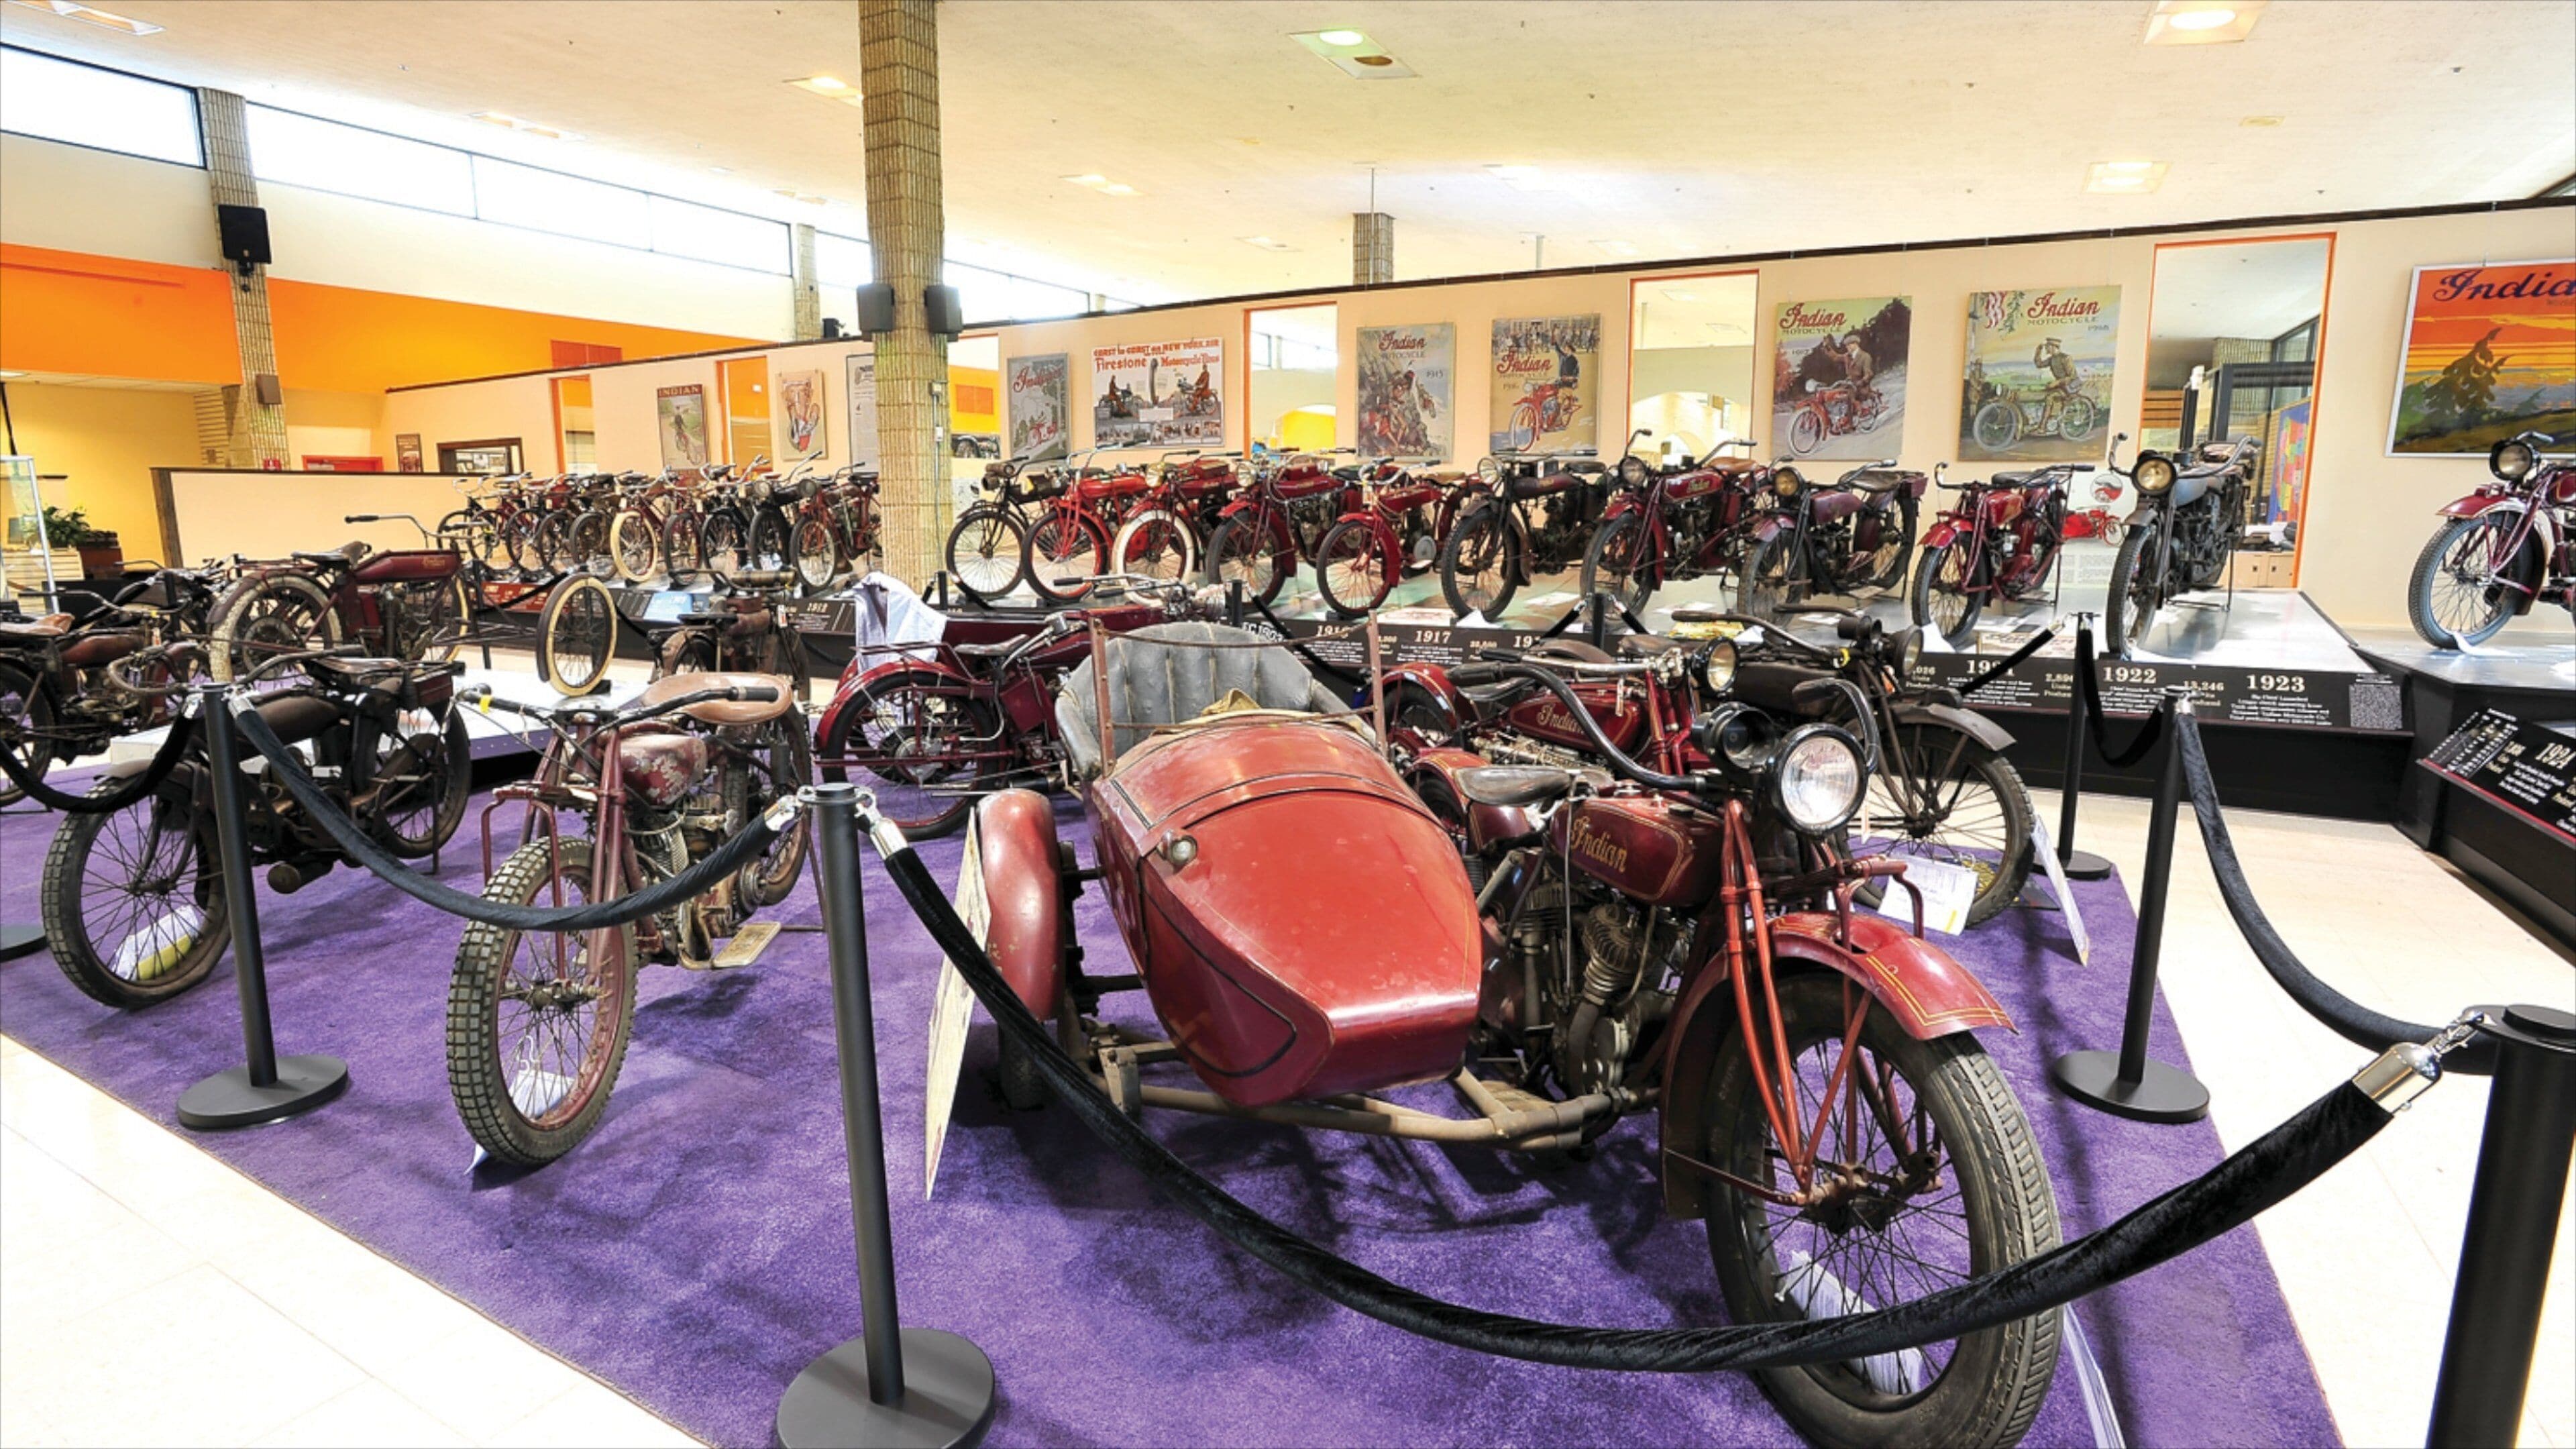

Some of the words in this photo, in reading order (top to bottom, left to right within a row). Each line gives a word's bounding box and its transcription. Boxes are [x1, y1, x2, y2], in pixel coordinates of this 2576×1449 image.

[1779, 303, 1846, 329] Indian
[2027, 292, 2100, 318] Indian
[1379, 331, 1426, 351] Indian
[1095, 358, 1147, 373] Firestone
[1497, 346, 1552, 374] Indian
[1013, 365, 1064, 393] Indian
[1415, 630, 1452, 644] 1917
[2102, 666, 2157, 684] 1922
[2247, 674, 2306, 692] 1923
[1571, 816, 1627, 872] Indian
